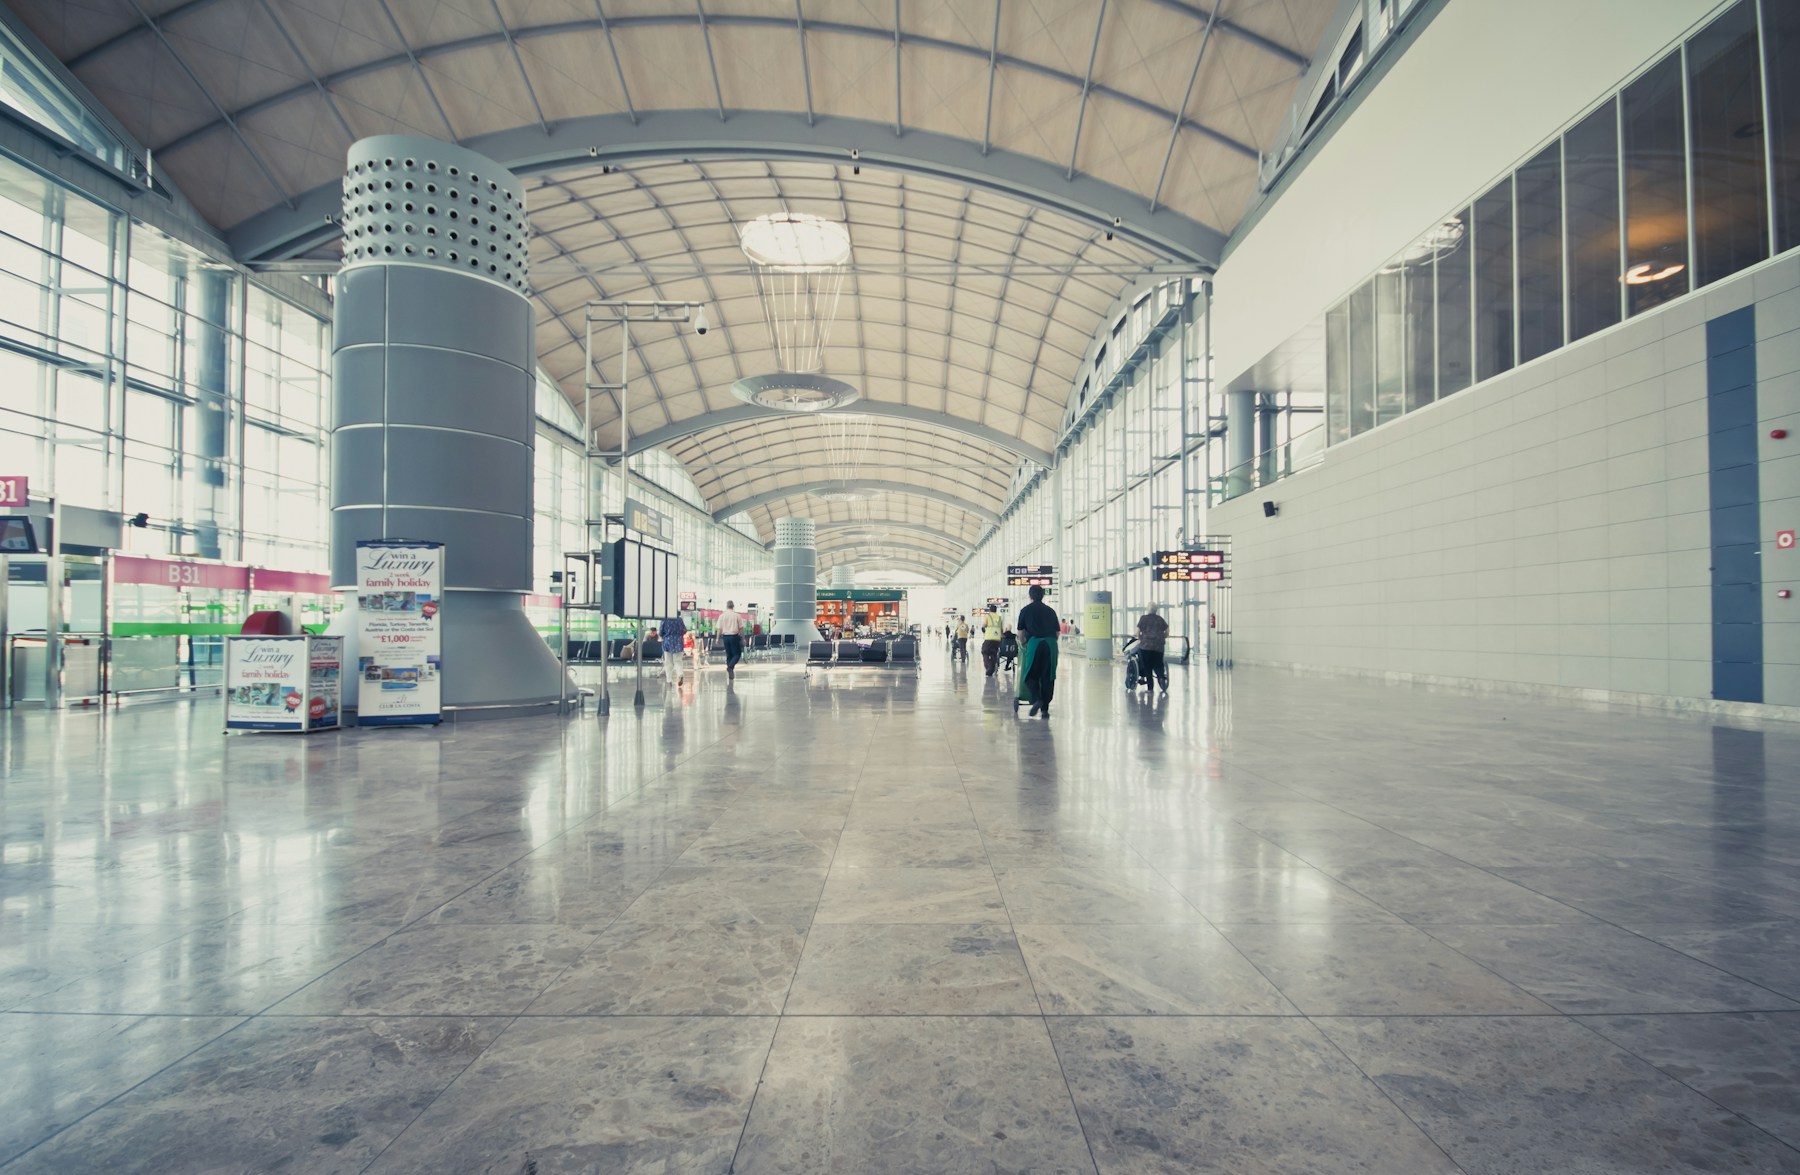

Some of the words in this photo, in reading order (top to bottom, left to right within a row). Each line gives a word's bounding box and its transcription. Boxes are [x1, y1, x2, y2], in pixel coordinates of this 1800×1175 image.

[391, 551, 408, 560] win
[361, 549, 435, 576] Luxury
[168, 564, 201, 584] B31
[366, 577, 394, 589] family
[397, 577, 431, 589] holiday
[381, 635, 409, 643] £1,000
[261, 645, 274, 653] win
[241, 643, 294, 669] Luxury
[242, 670, 262, 680] family
[264, 669, 290, 679] holiday
